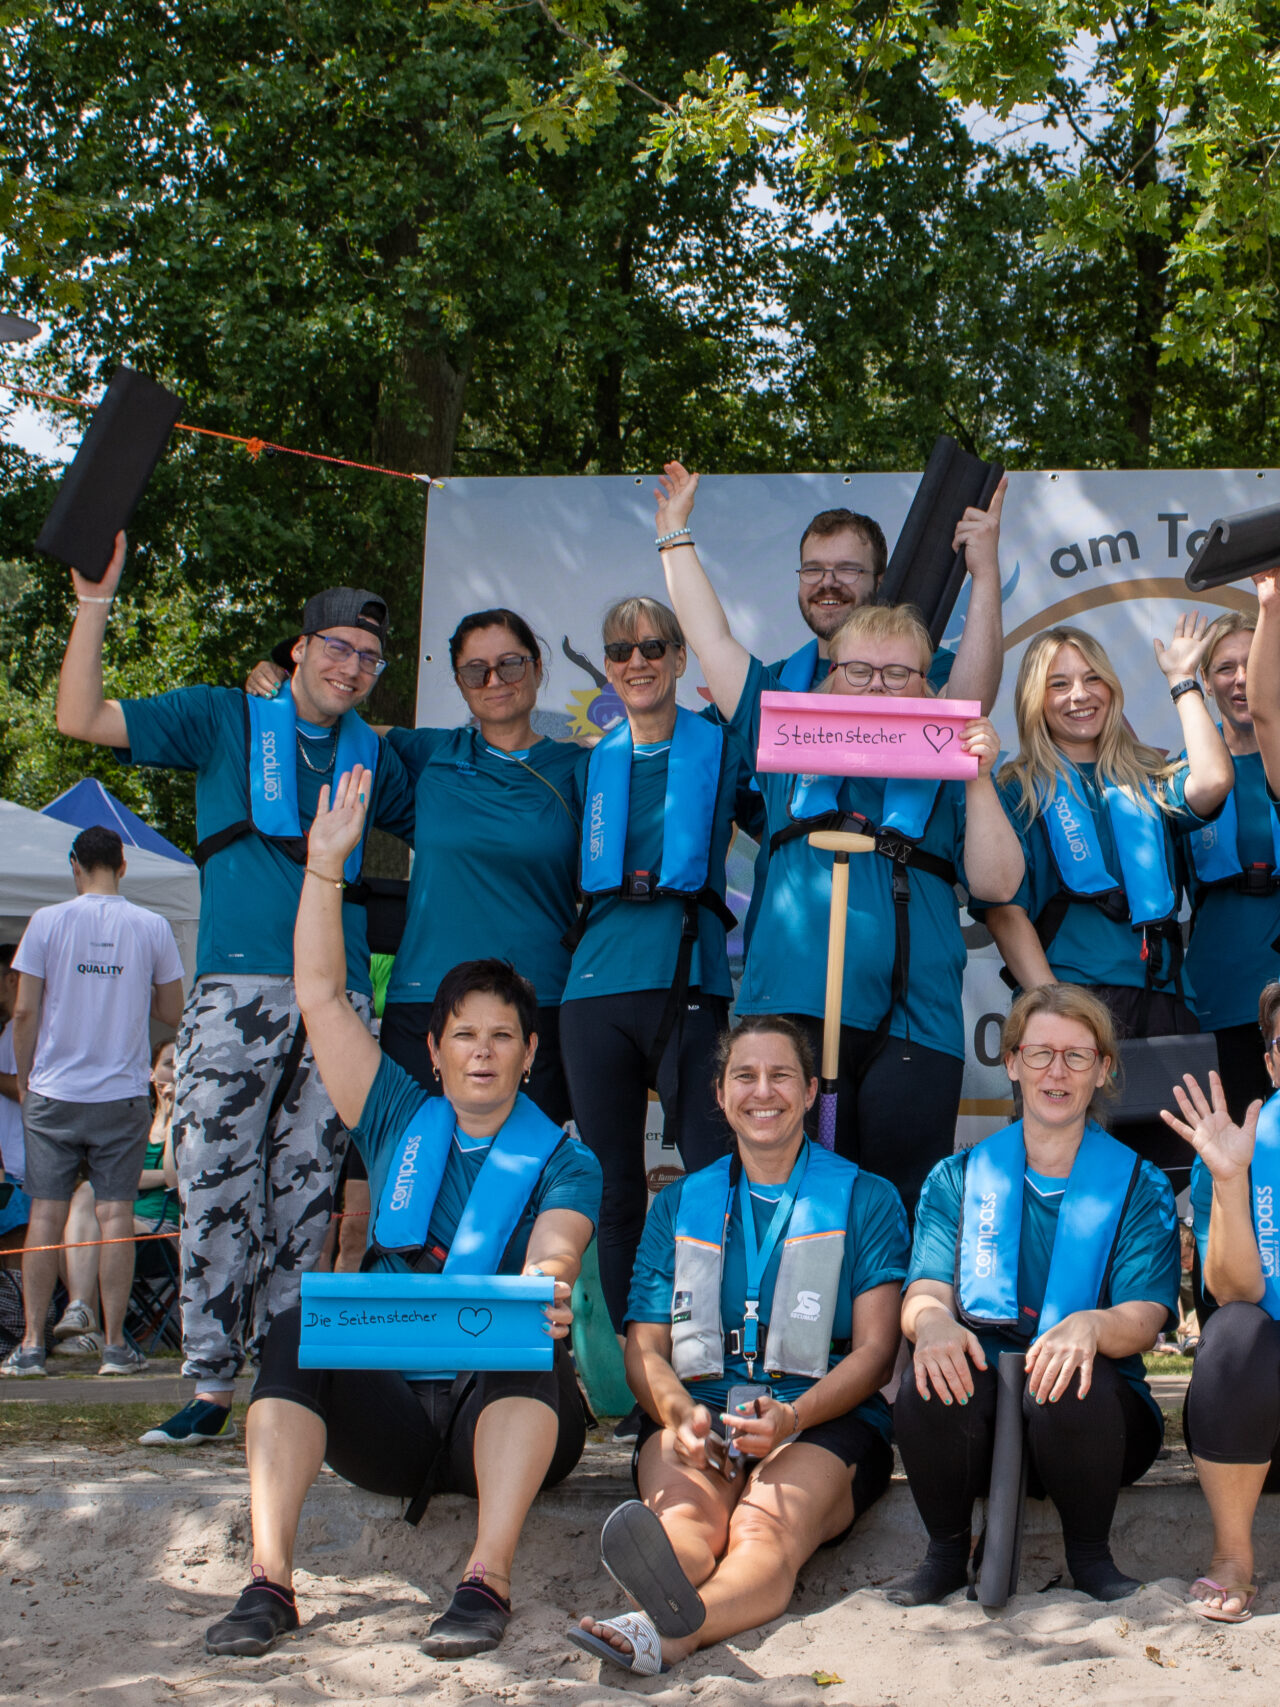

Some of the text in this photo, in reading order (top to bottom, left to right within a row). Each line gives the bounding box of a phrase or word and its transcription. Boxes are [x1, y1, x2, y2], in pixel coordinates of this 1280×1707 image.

[1050, 530, 1140, 578] am
[261, 730, 281, 802] compass
[774, 723, 907, 746] Steitenstecher
[590, 792, 606, 861] compass
[1053, 795, 1087, 862] compass
[77, 963, 124, 975] QUALITY
[389, 1134, 422, 1212] compass
[976, 1191, 999, 1278] compass
[1256, 1185, 1279, 1278] compass
[304, 1309, 438, 1328] Die Seitenstecher
